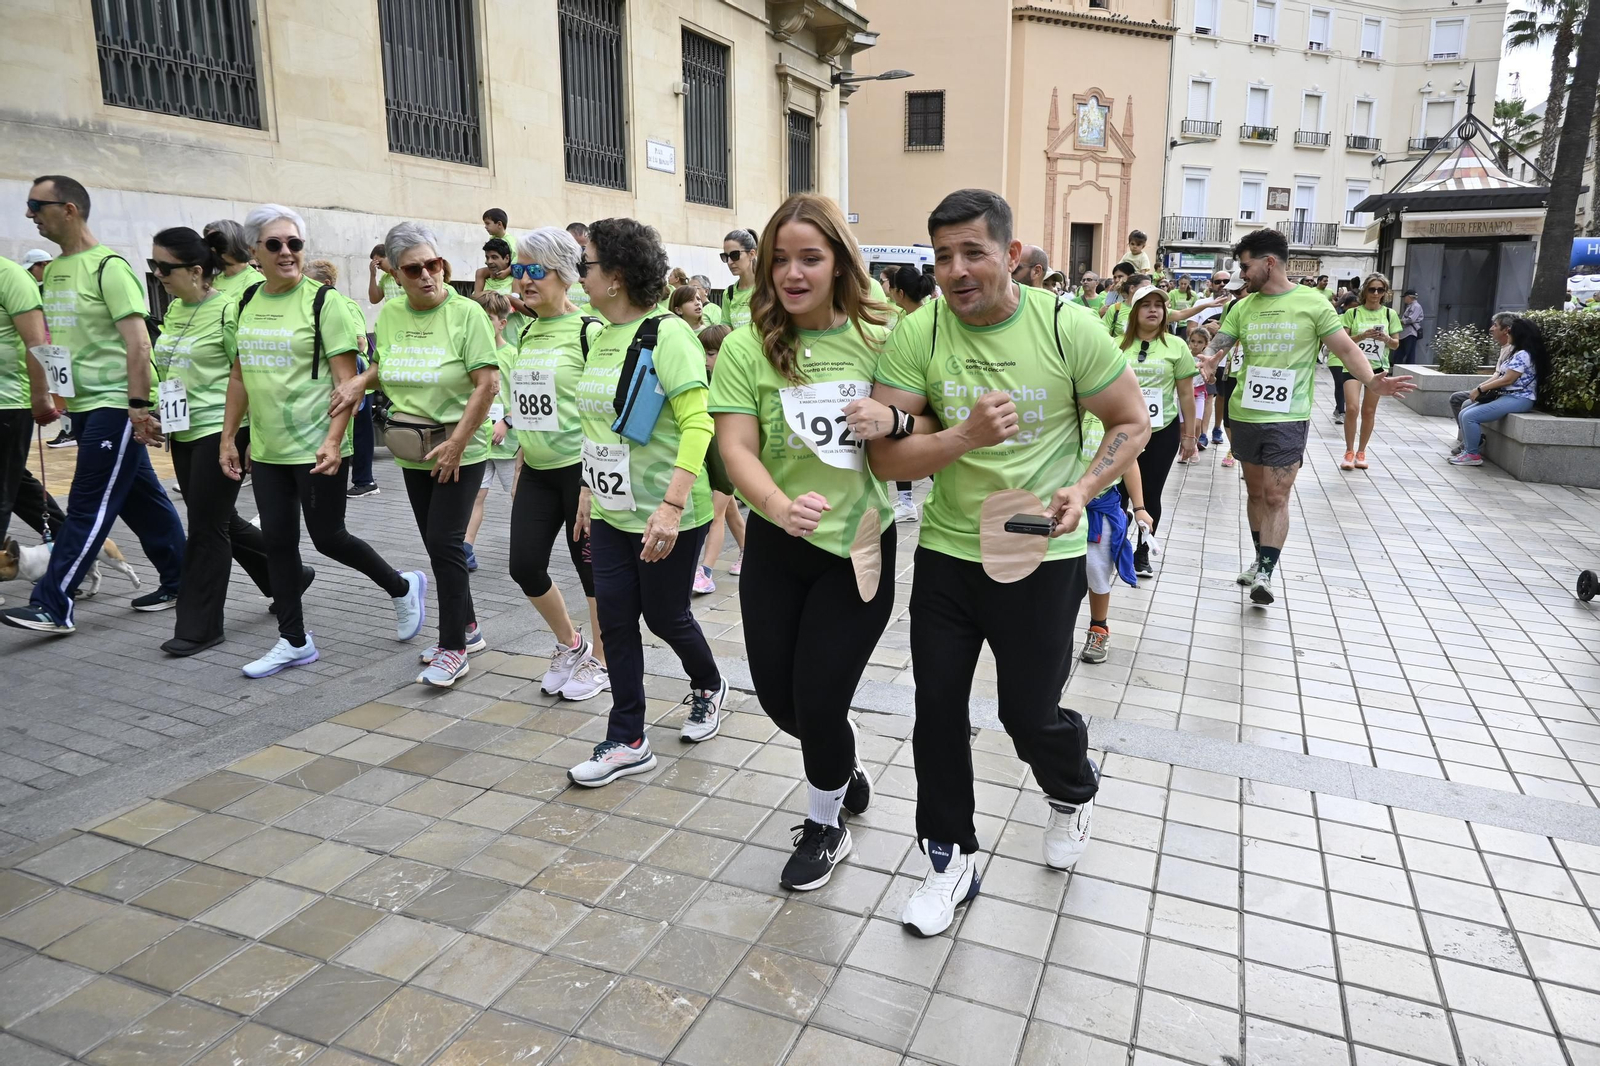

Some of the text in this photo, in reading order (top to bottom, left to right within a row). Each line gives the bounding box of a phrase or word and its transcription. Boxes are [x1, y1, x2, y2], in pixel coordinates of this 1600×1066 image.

[1429, 222, 1466, 235] BURGUER
[1467, 221, 1513, 234] FERNANDO
[1587, 243, 1600, 255] H
[251, 326, 295, 338] marcha
[1248, 321, 1298, 331] En marcha
[1246, 330, 1296, 341] contra el
[236, 338, 293, 353] contra el
[390, 344, 446, 356] En marcha
[1247, 340, 1295, 353] cáncer
[238, 350, 293, 368] cáncer
[385, 356, 442, 369] contra el
[515, 357, 559, 368] contra el
[381, 368, 443, 384] cáncer
[591, 367, 621, 378] march
[575, 379, 617, 395] ontra e
[944, 380, 1048, 402] En mrcha
[1248, 380, 1289, 402] 1928
[513, 389, 553, 416] 1888
[575, 393, 616, 414] ánce
[1022, 405, 1045, 424] el
[1148, 403, 1159, 418] 9
[795, 411, 862, 449] 192
